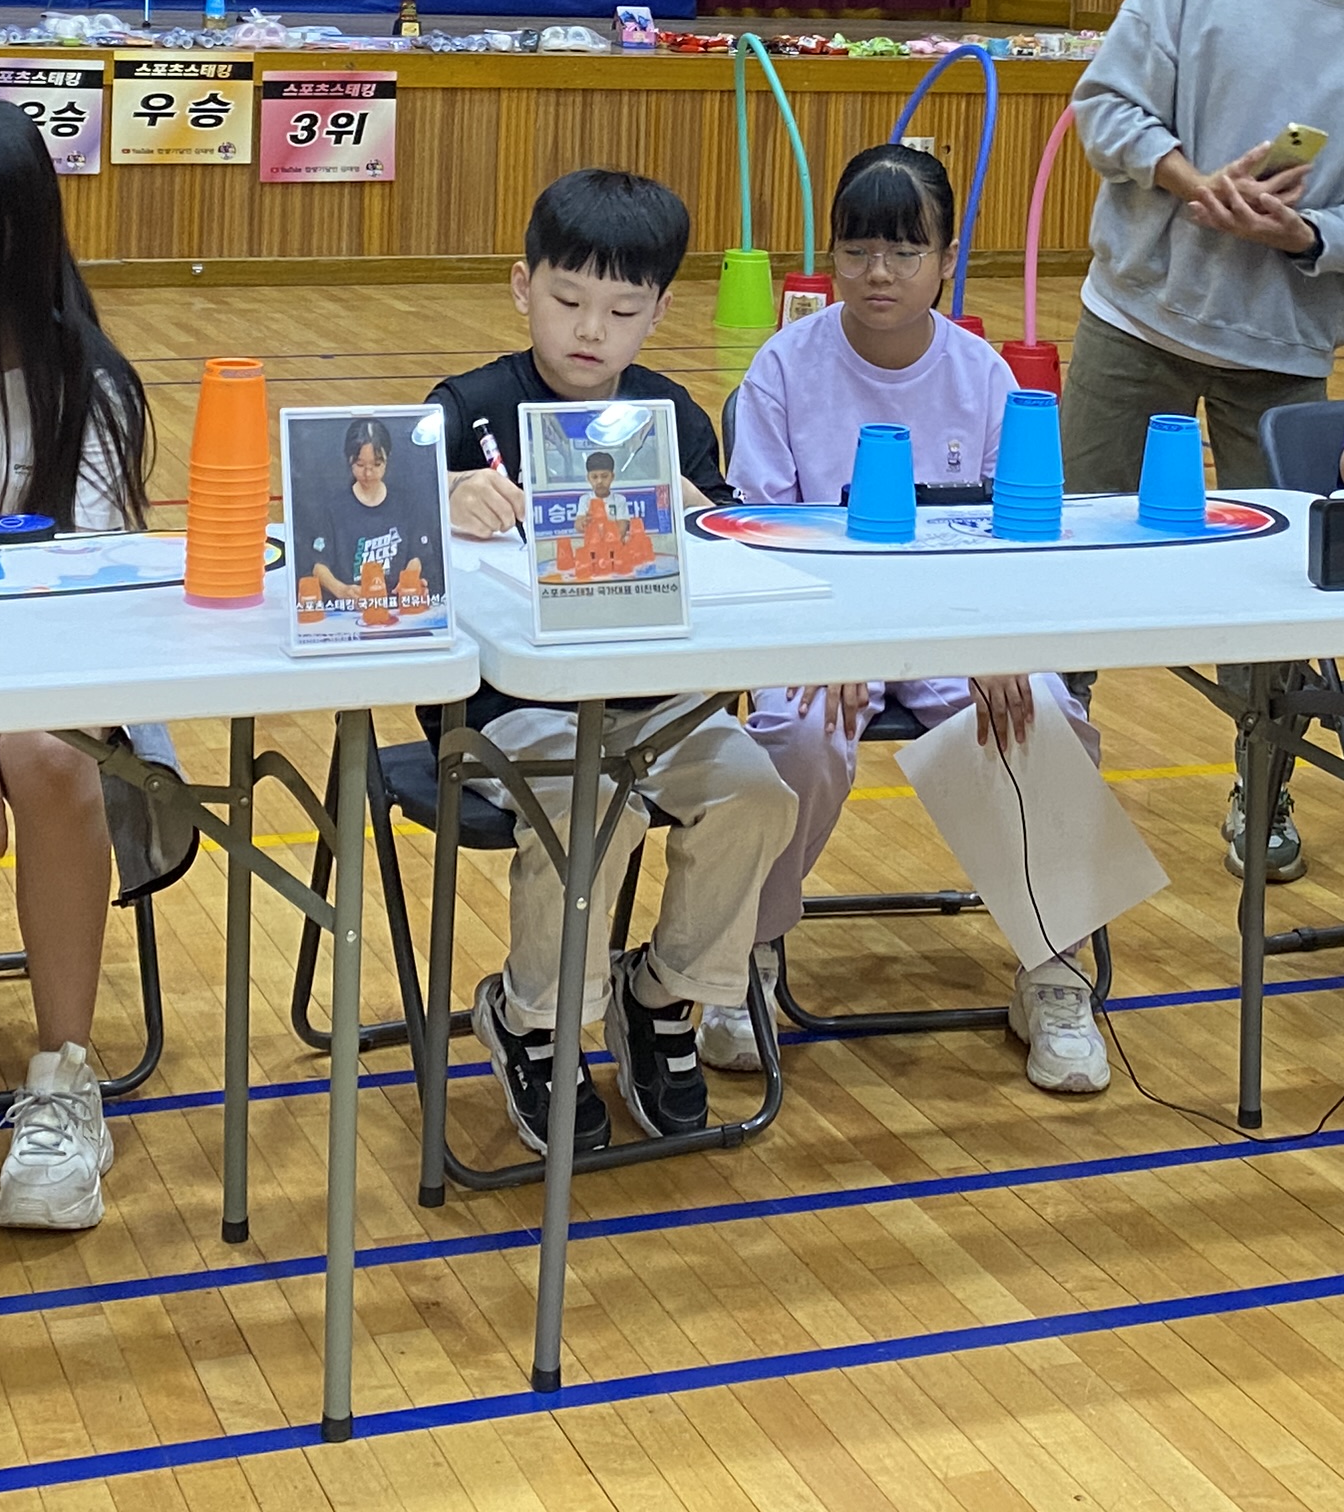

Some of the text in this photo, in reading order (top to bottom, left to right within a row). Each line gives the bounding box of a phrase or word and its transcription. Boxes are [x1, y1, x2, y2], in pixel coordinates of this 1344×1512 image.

[133, 63, 234, 79] 스포츠스태킹
[281, 83, 377, 97] 스포츠스태킹
[132, 92, 233, 129] 우승
[287, 111, 370, 146] 3위
[358, 595, 398, 609] 국가대표
